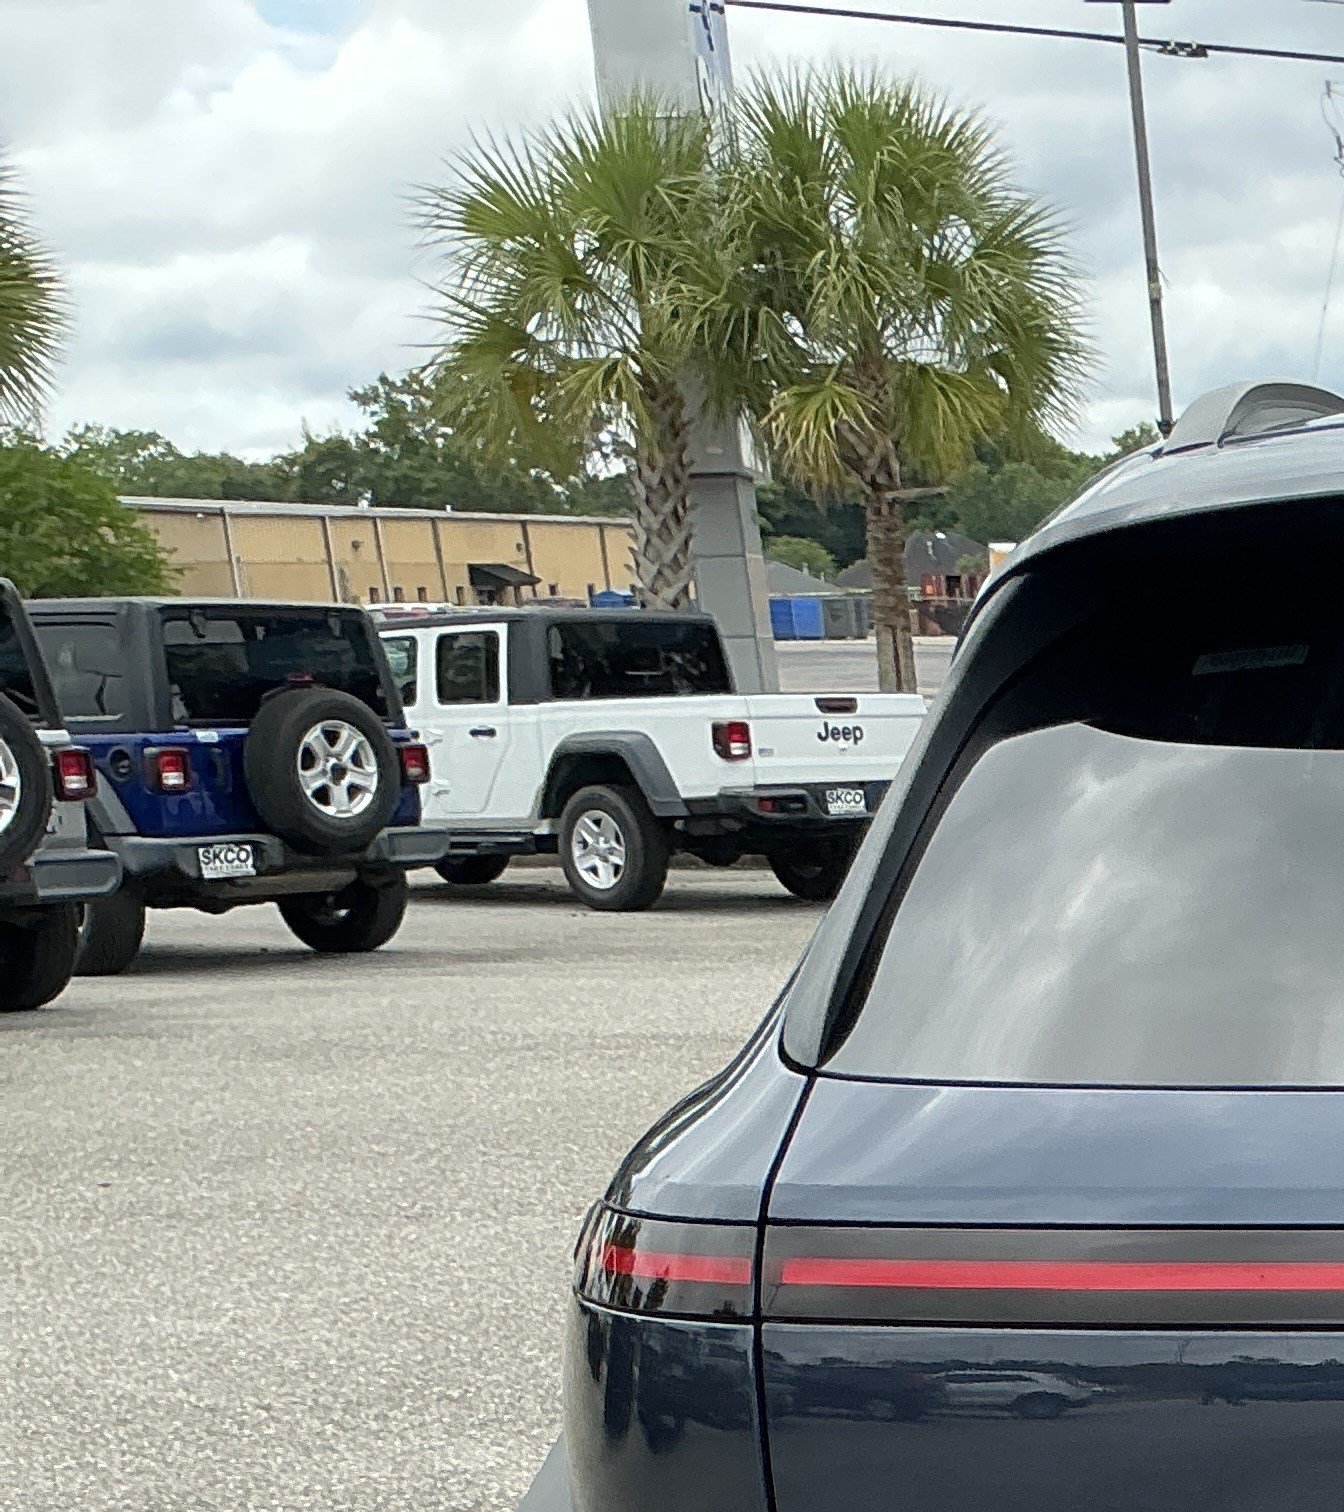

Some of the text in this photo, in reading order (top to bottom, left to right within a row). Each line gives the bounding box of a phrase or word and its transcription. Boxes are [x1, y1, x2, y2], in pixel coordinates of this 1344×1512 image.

[816, 721, 864, 745] Jeep
[827, 790, 863, 804] SKCO
[201, 847, 251, 866] SKCO
